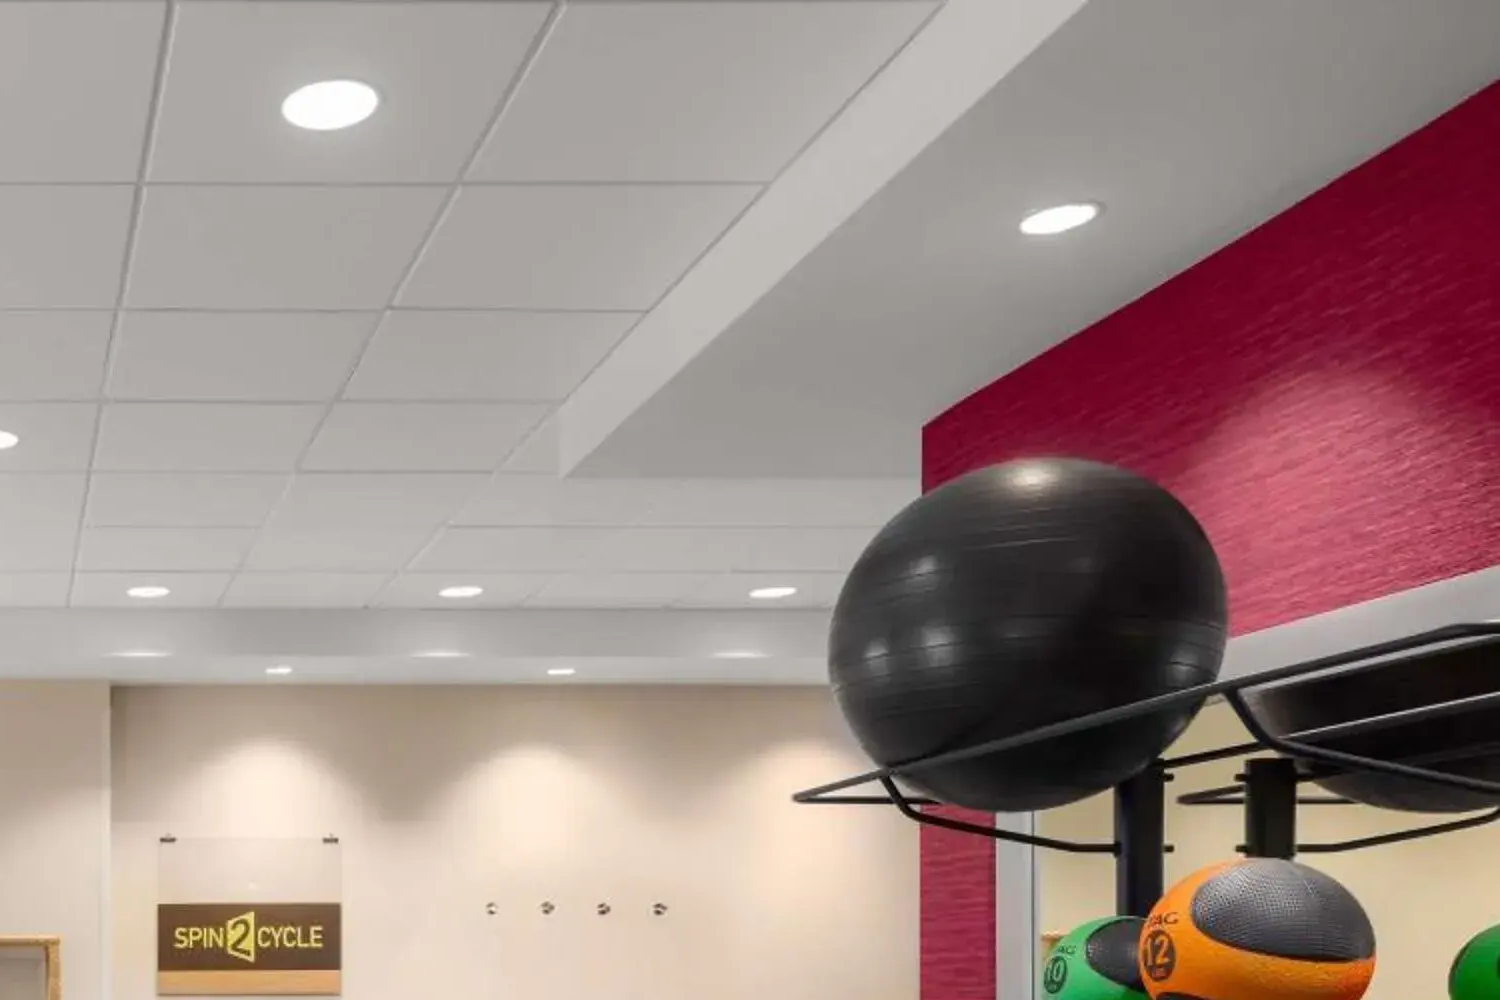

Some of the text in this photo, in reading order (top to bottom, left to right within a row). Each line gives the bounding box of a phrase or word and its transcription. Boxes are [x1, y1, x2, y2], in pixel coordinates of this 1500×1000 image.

[174, 927, 225, 948] SPIN
[257, 926, 323, 948] CYCLE
[1146, 935, 1170, 967] 12
